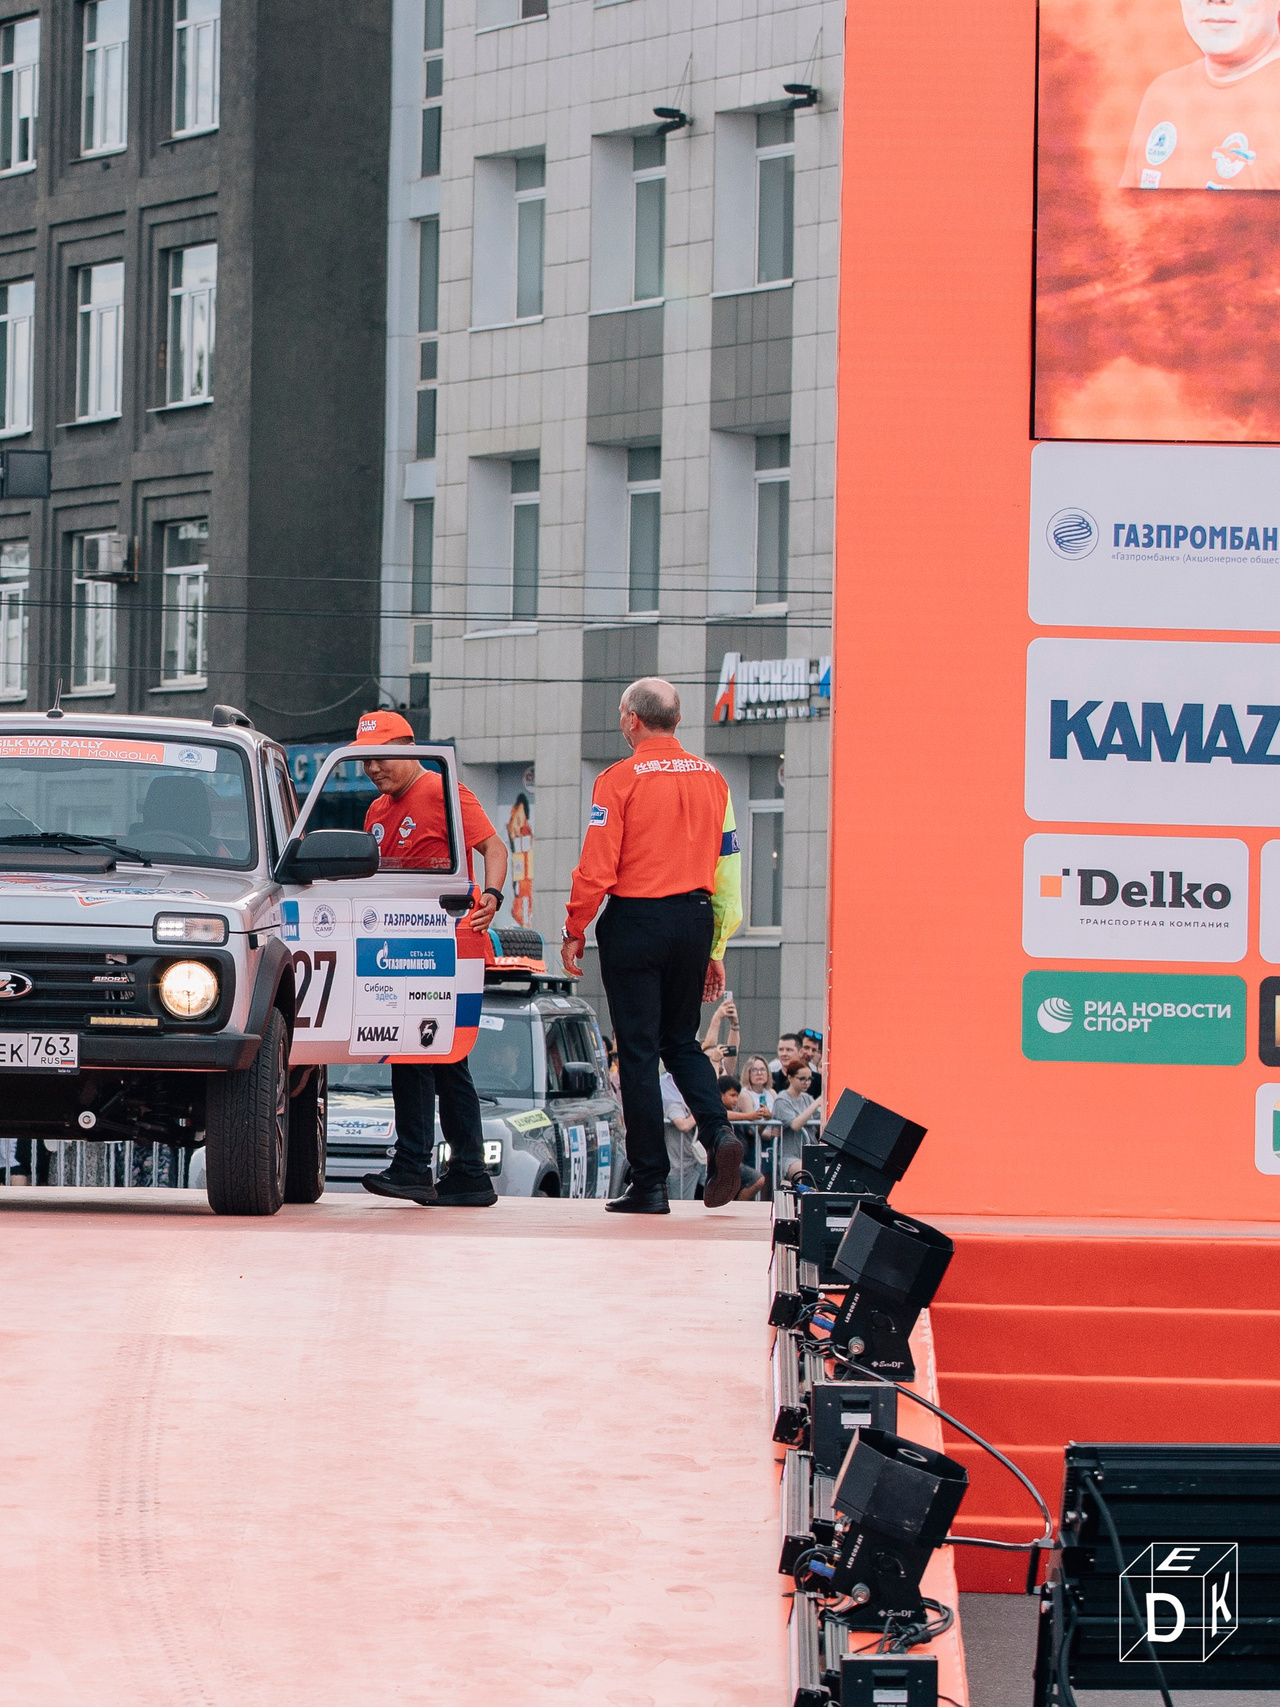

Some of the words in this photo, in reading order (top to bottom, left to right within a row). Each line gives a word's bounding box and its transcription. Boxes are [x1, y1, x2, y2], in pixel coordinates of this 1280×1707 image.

[1114, 523, 1279, 551] ГАЗПРОМБАН
[1183, 554, 1247, 564] (Акционерное
[1250, 556, 1280, 564] общес
[1049, 699, 1279, 765] KAMAZ
[27, 739, 58, 748] WAY
[61, 740, 103, 748] RALLY
[19, 747, 71, 756] EDITION
[88, 750, 158, 761] MONGOLIA
[1077, 869, 1231, 910] Delko
[384, 914, 447, 926] ГАЗПРОМБАНК
[1080, 919, 1164, 927] ТРАНСПОРТНАЯ
[364, 983, 393, 993] Сибирь
[375, 993, 398, 1001] здесь
[409, 992, 451, 1000] MONGOLIA
[1084, 1001, 1126, 1016] РИА
[1133, 1002, 1231, 1018] НОВОСТИ
[1083, 1017, 1152, 1032] СПОРТ
[357, 1027, 399, 1041] KAMAZ
[31, 1036, 70, 1056] 763
